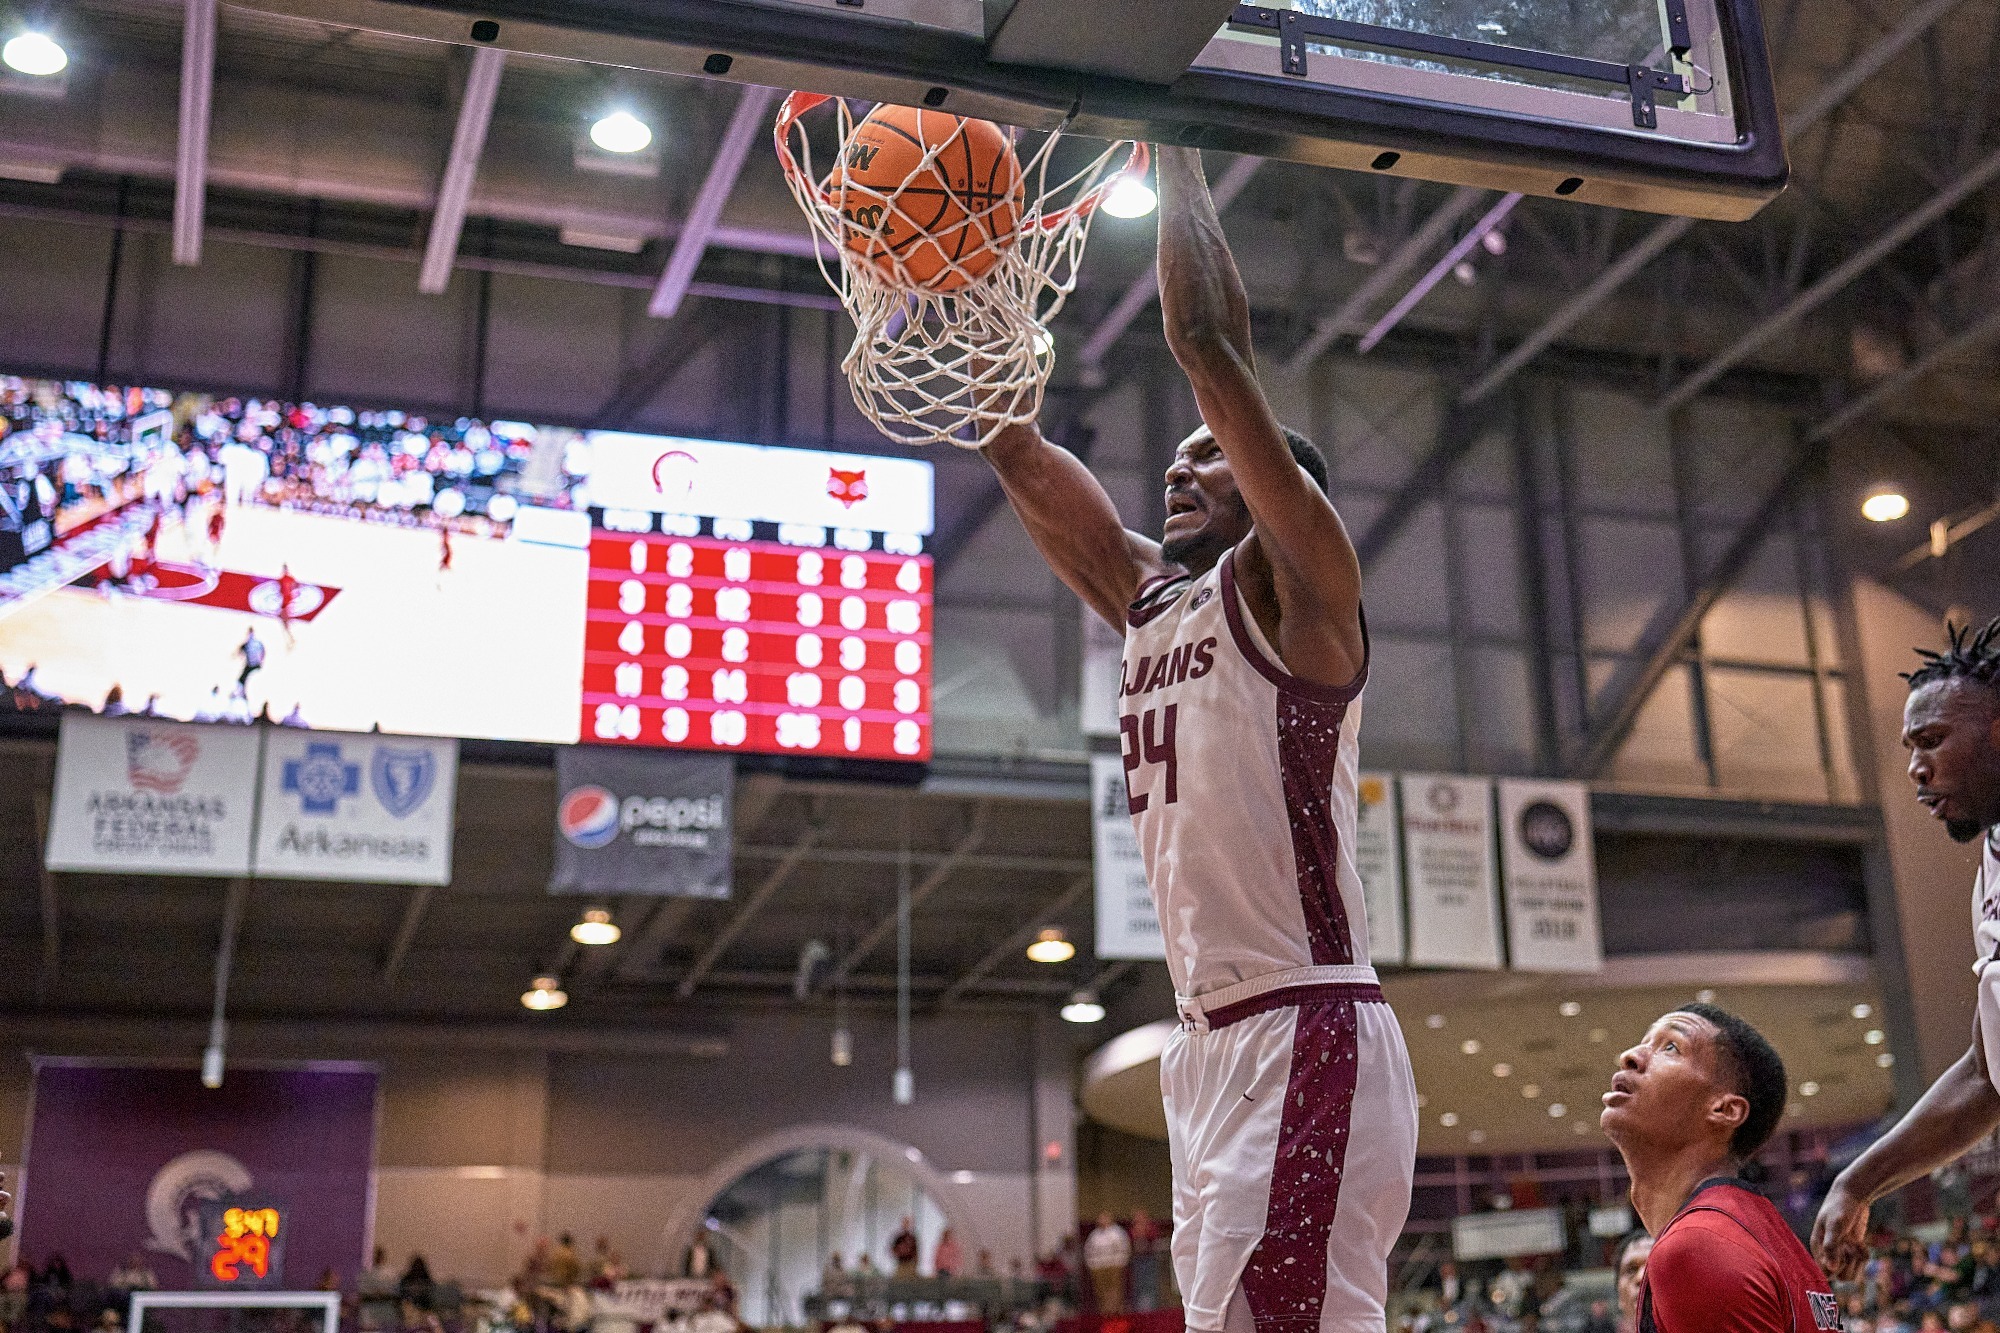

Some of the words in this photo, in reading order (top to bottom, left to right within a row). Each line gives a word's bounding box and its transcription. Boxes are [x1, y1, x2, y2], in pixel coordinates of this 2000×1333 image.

[1120, 703, 1178, 815] 24
[87, 791, 226, 820] ARKANSAS
[620, 793, 724, 833] pepsi
[94, 817, 212, 840] FEDERAL
[277, 823, 430, 863] Arkansas
[211, 1232, 270, 1282] 29
